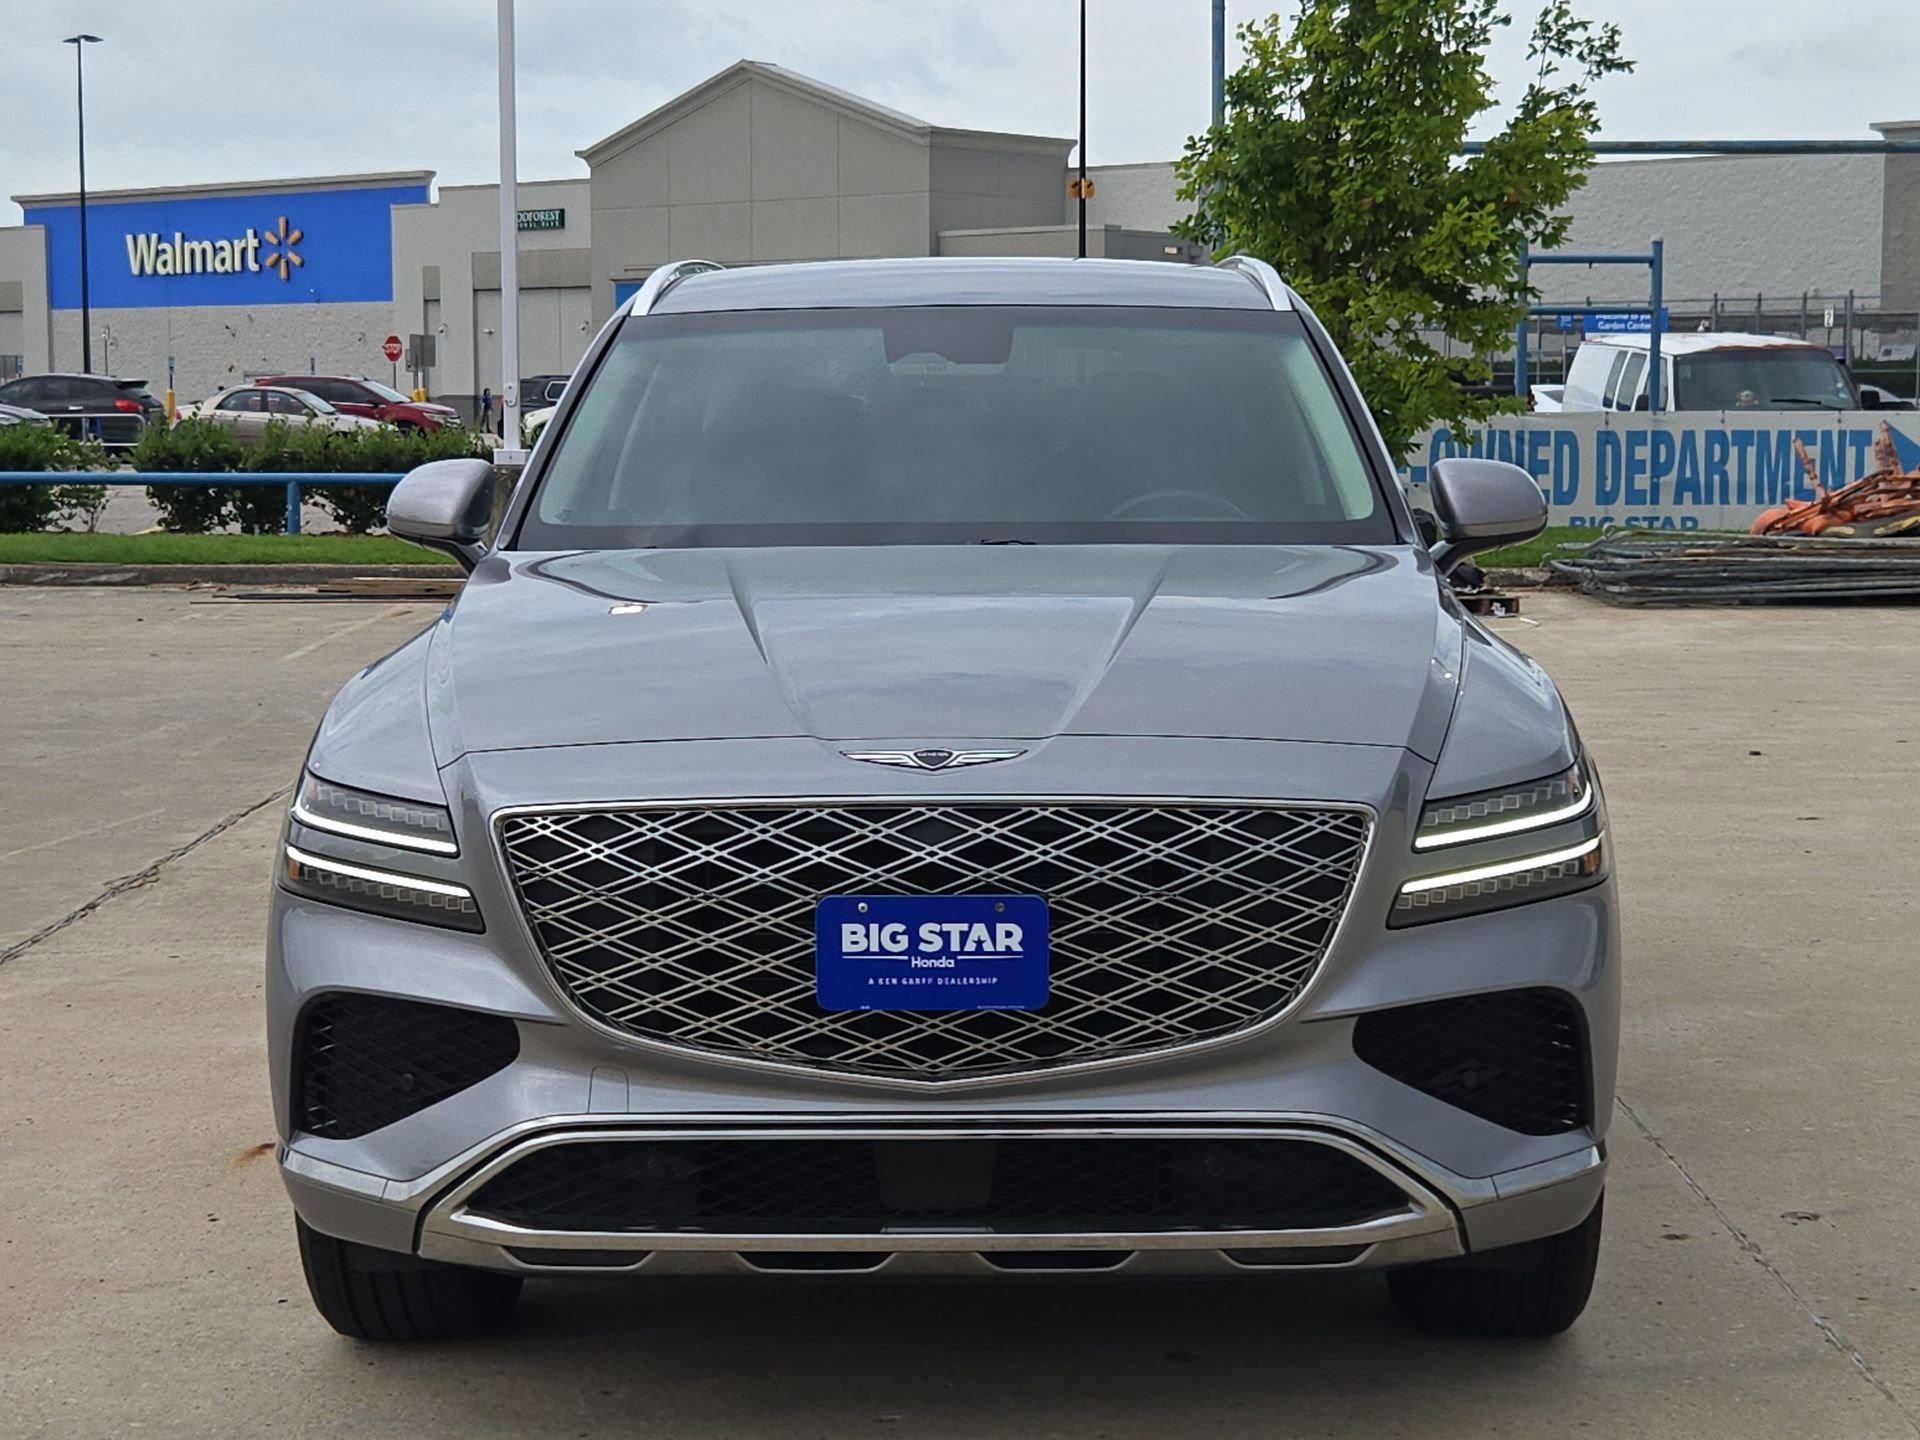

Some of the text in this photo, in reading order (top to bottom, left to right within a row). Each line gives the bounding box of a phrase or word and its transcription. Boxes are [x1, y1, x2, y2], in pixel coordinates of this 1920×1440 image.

[126, 229, 260, 275] Walmart
[1595, 429, 1873, 506] DEPARTMENT
[841, 922, 1024, 953] BIG STAR
[911, 955, 955, 968] Honda
[868, 977, 875, 985] A
[878, 977, 898, 985] KEN
[937, 977, 998, 985] DEALERSHIP
